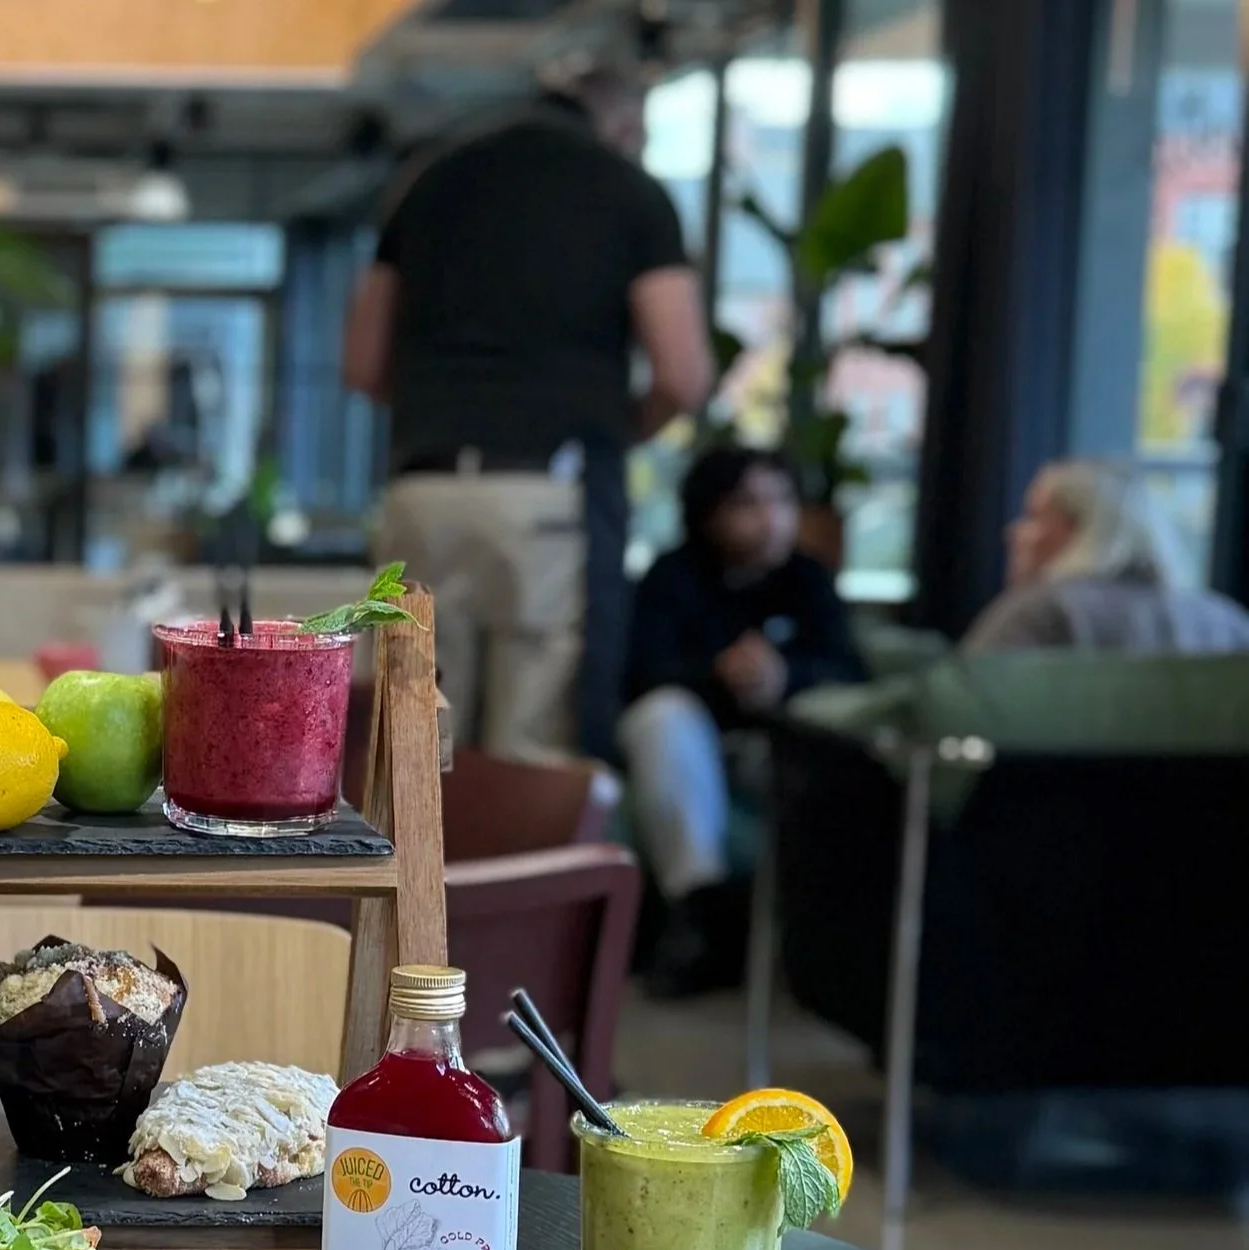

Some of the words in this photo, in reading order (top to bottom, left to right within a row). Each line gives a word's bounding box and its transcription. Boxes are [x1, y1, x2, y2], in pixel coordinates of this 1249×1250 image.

[340, 1157, 385, 1181] JUICED
[409, 1172, 501, 1200] cotton.
[440, 1231, 472, 1245] COLD
